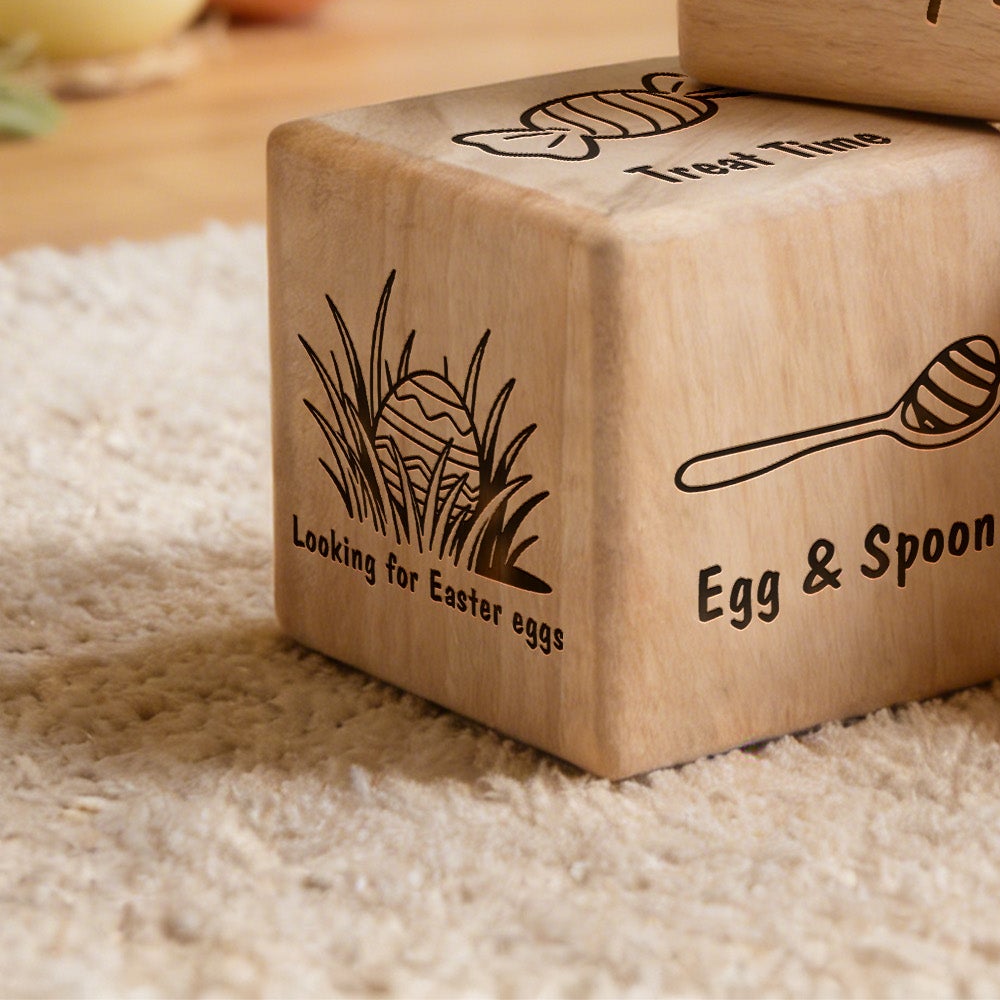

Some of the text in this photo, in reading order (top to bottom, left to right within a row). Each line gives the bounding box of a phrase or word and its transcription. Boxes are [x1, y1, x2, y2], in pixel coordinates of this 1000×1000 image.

[623, 133, 892, 183] Treat Time
[293, 514, 564, 655] Looking for Easter eggs
[698, 514, 995, 631] Egg & Spoon
